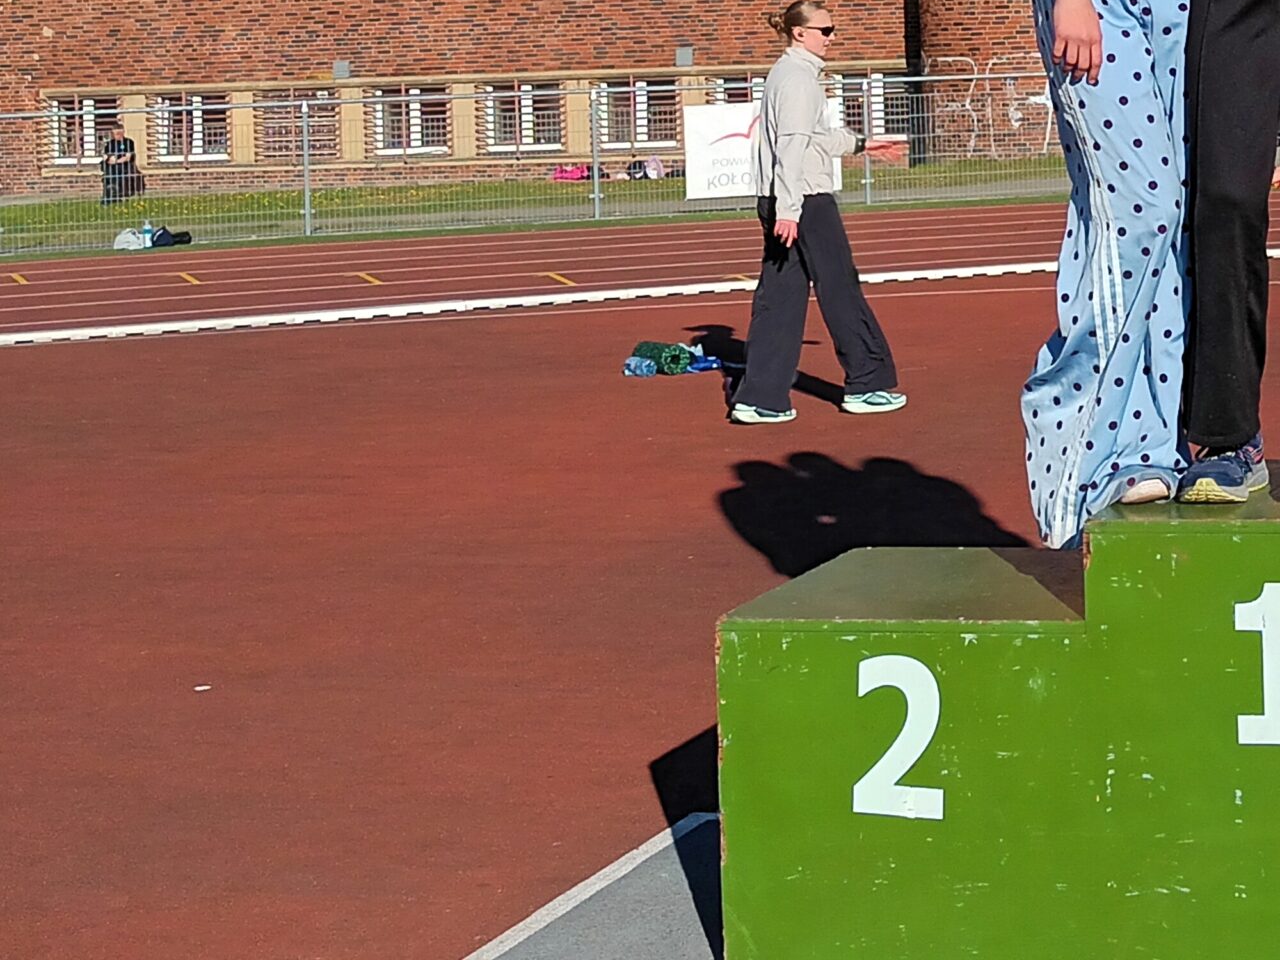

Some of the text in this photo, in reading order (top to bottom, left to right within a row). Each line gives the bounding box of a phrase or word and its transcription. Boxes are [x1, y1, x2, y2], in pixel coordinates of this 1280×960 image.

[711, 156, 753, 167] POWIA
[707, 171, 753, 190] KOŁO
[852, 654, 944, 820] 2
